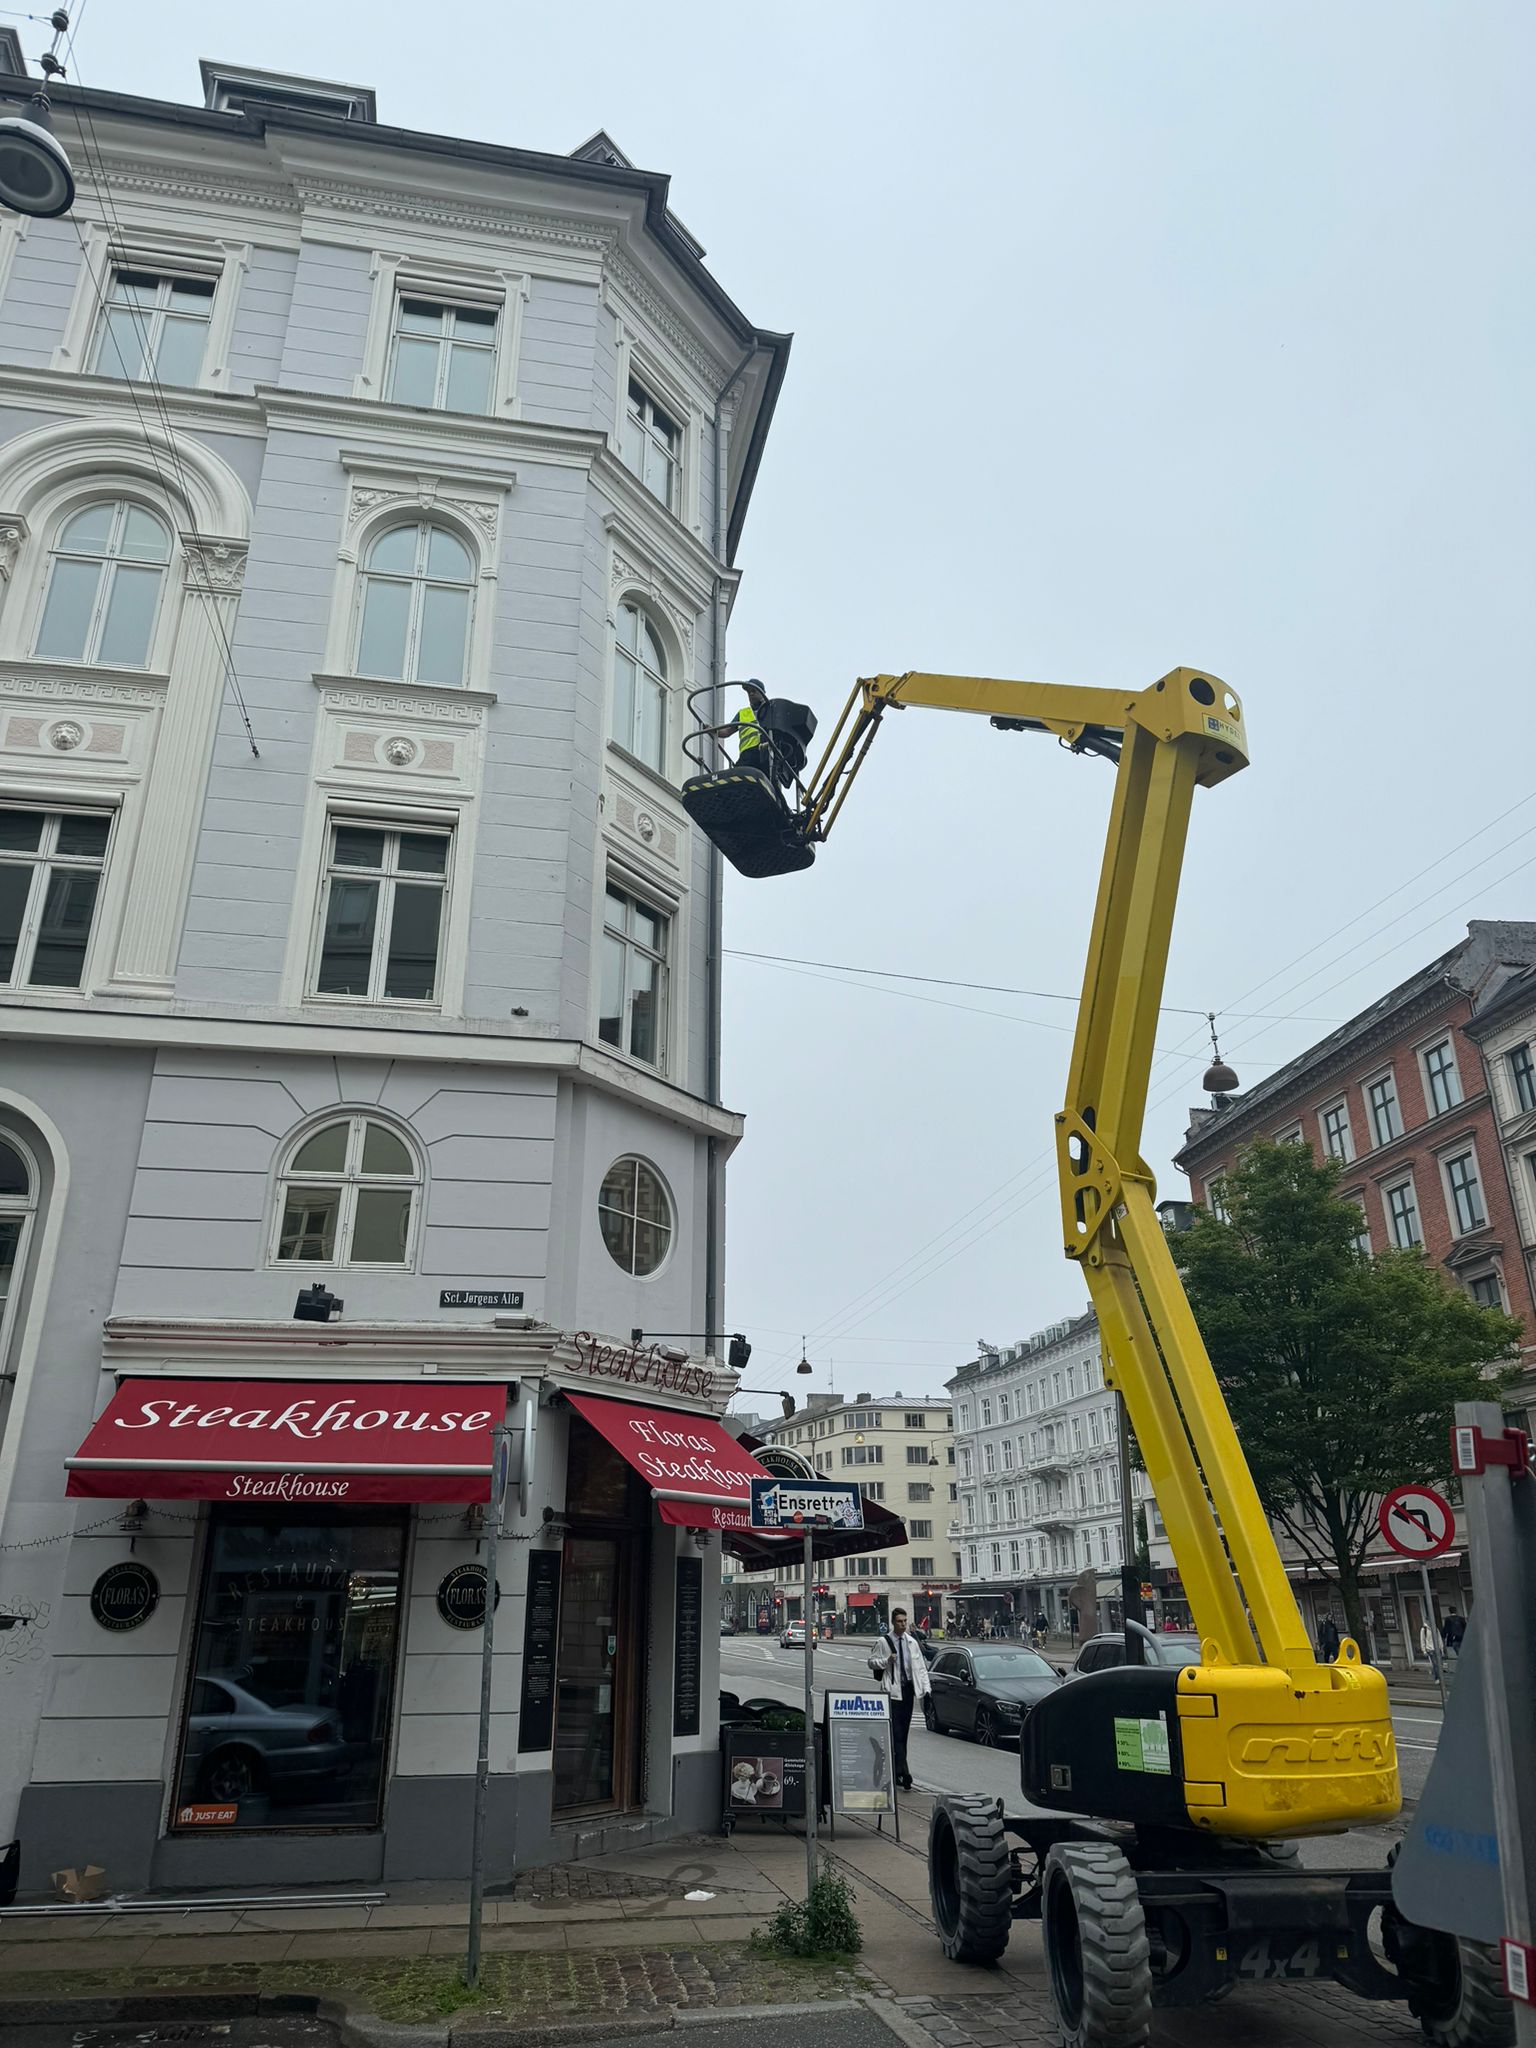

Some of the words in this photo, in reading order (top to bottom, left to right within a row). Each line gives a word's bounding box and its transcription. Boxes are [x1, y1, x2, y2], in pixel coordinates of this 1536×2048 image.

[444, 1292, 462, 1303] Sct.
[463, 1292, 499, 1306] Jørgens
[564, 1331, 714, 1398] Steakhouse
[115, 1400, 492, 1439] Steakhouse
[629, 1420, 716, 1454] Floras
[761, 1455, 800, 1471] EAKHOUSE
[226, 1473, 349, 1501] Steakhouse
[712, 1507, 752, 1529] Restaur
[228, 1563, 349, 1601] RESTAURA
[450, 1565, 488, 1578] STEAKHOUS
[235, 1617, 345, 1632] STEAKHOUS
[445, 1614, 485, 1628] RESTAURAN
[834, 1695, 885, 1711] LAVAZZA
[1241, 1728, 1394, 1768] nifty
[194, 1811, 217, 1821] JUST
[217, 1811, 235, 1820] EAT
[1240, 1937, 1321, 1978] 4x4
